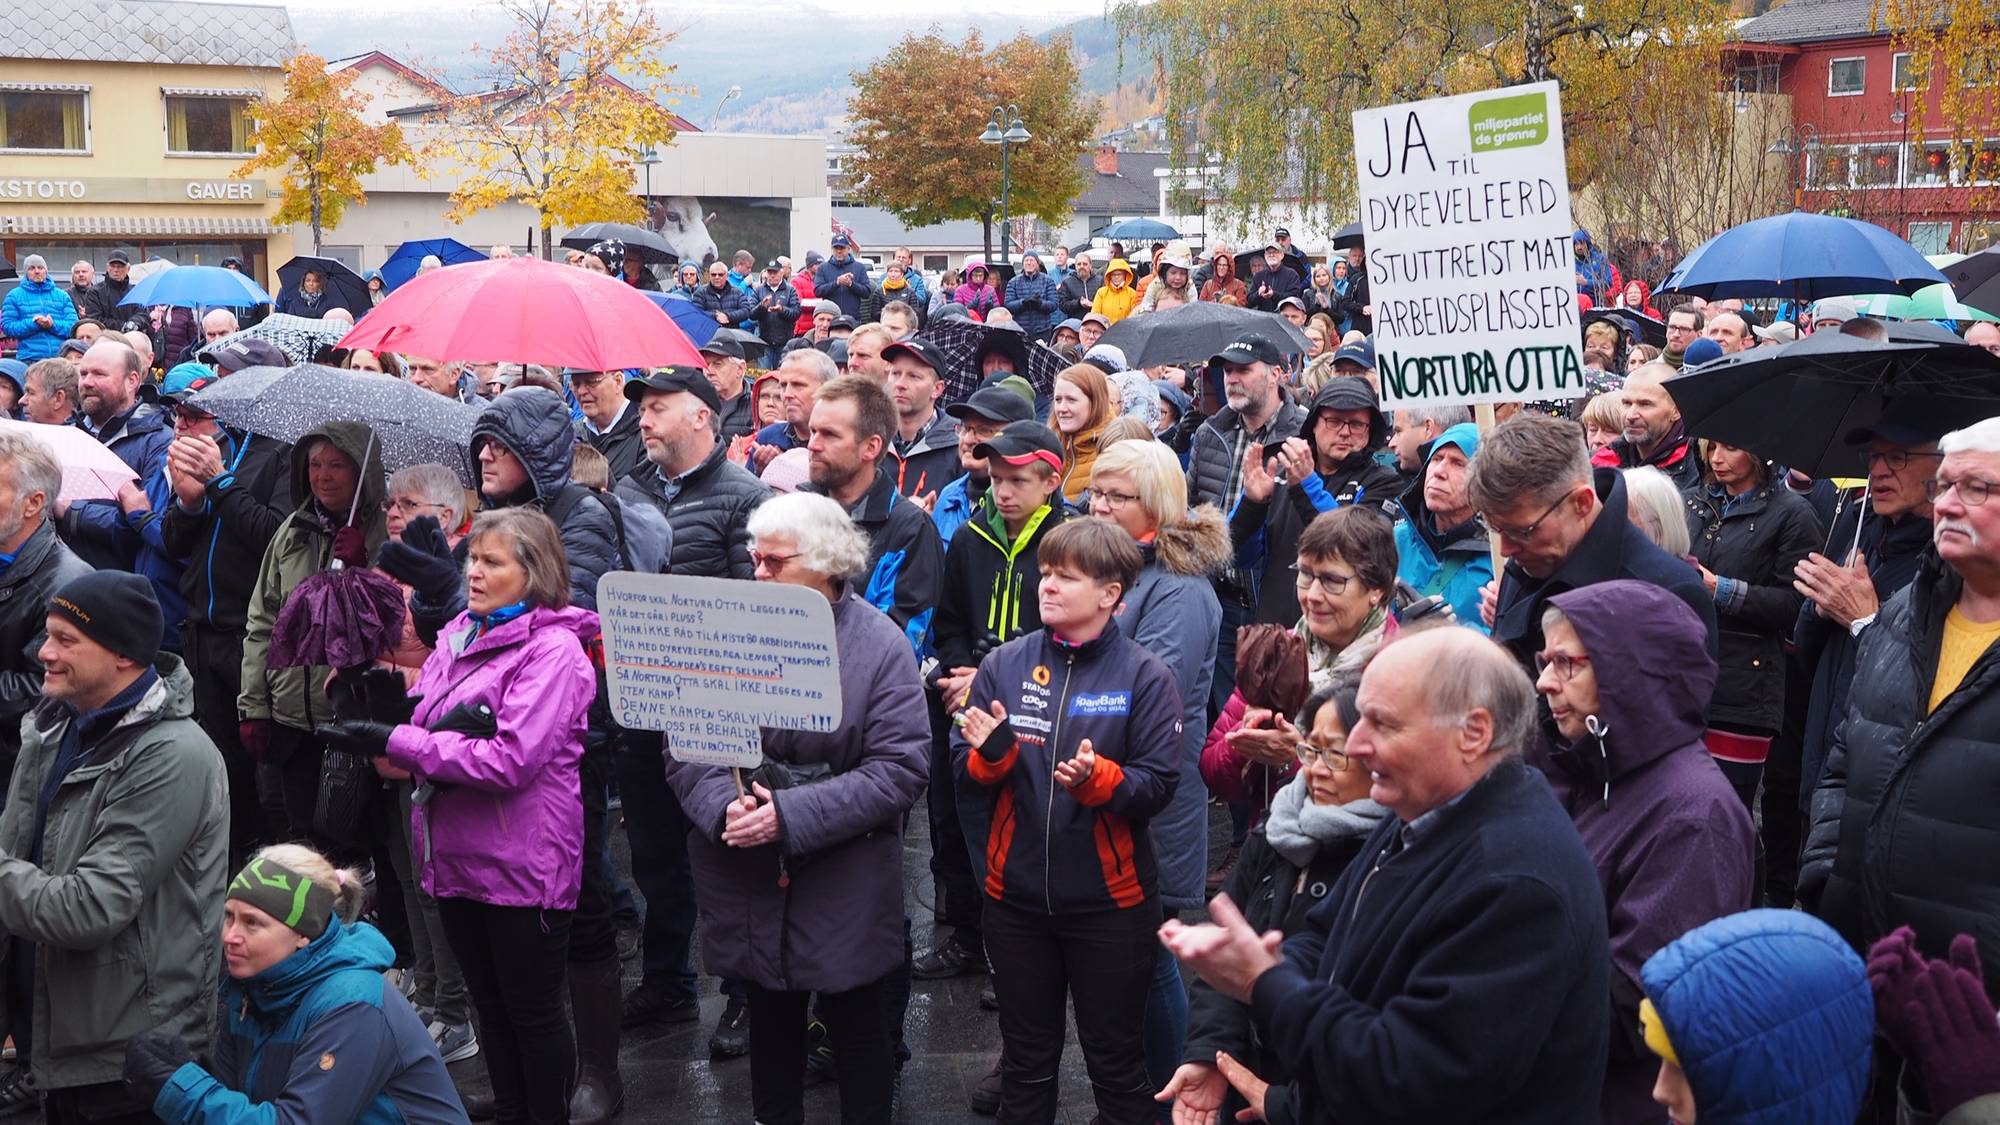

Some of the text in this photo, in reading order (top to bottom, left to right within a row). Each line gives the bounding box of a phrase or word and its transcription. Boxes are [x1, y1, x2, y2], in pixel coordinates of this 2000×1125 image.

[1473, 111, 1544, 133] miljøpartiet
[1368, 111, 1436, 178] JA
[1475, 128, 1537, 146] de grønne
[186, 182, 254, 200] GAVER
[1369, 178, 1557, 232] DYREVELFERD
[1371, 236, 1571, 285] STUTTREIST MAT
[1377, 286, 1573, 338] ARBEIDSPLASSER
[1377, 344, 1583, 401] NORTURA OTTA
[609, 605, 628, 618] NÅR
[672, 593, 713, 609] NORTURA
[714, 598, 746, 612] OTTA
[673, 626, 693, 639] RÅD
[614, 634, 635, 650] HVA
[638, 641, 657, 652] MED
[614, 650, 645, 665] DETTE
[619, 685, 645, 696] UTEN
[632, 669, 673, 685] NORTURA
[673, 674, 699, 688] OTTA
[703, 679, 730, 692] SKAL
[804, 689, 823, 700] NED
[669, 704, 715, 719] KAMPEN
[648, 719, 661, 730] LA
[665, 720, 685, 732] OSS
